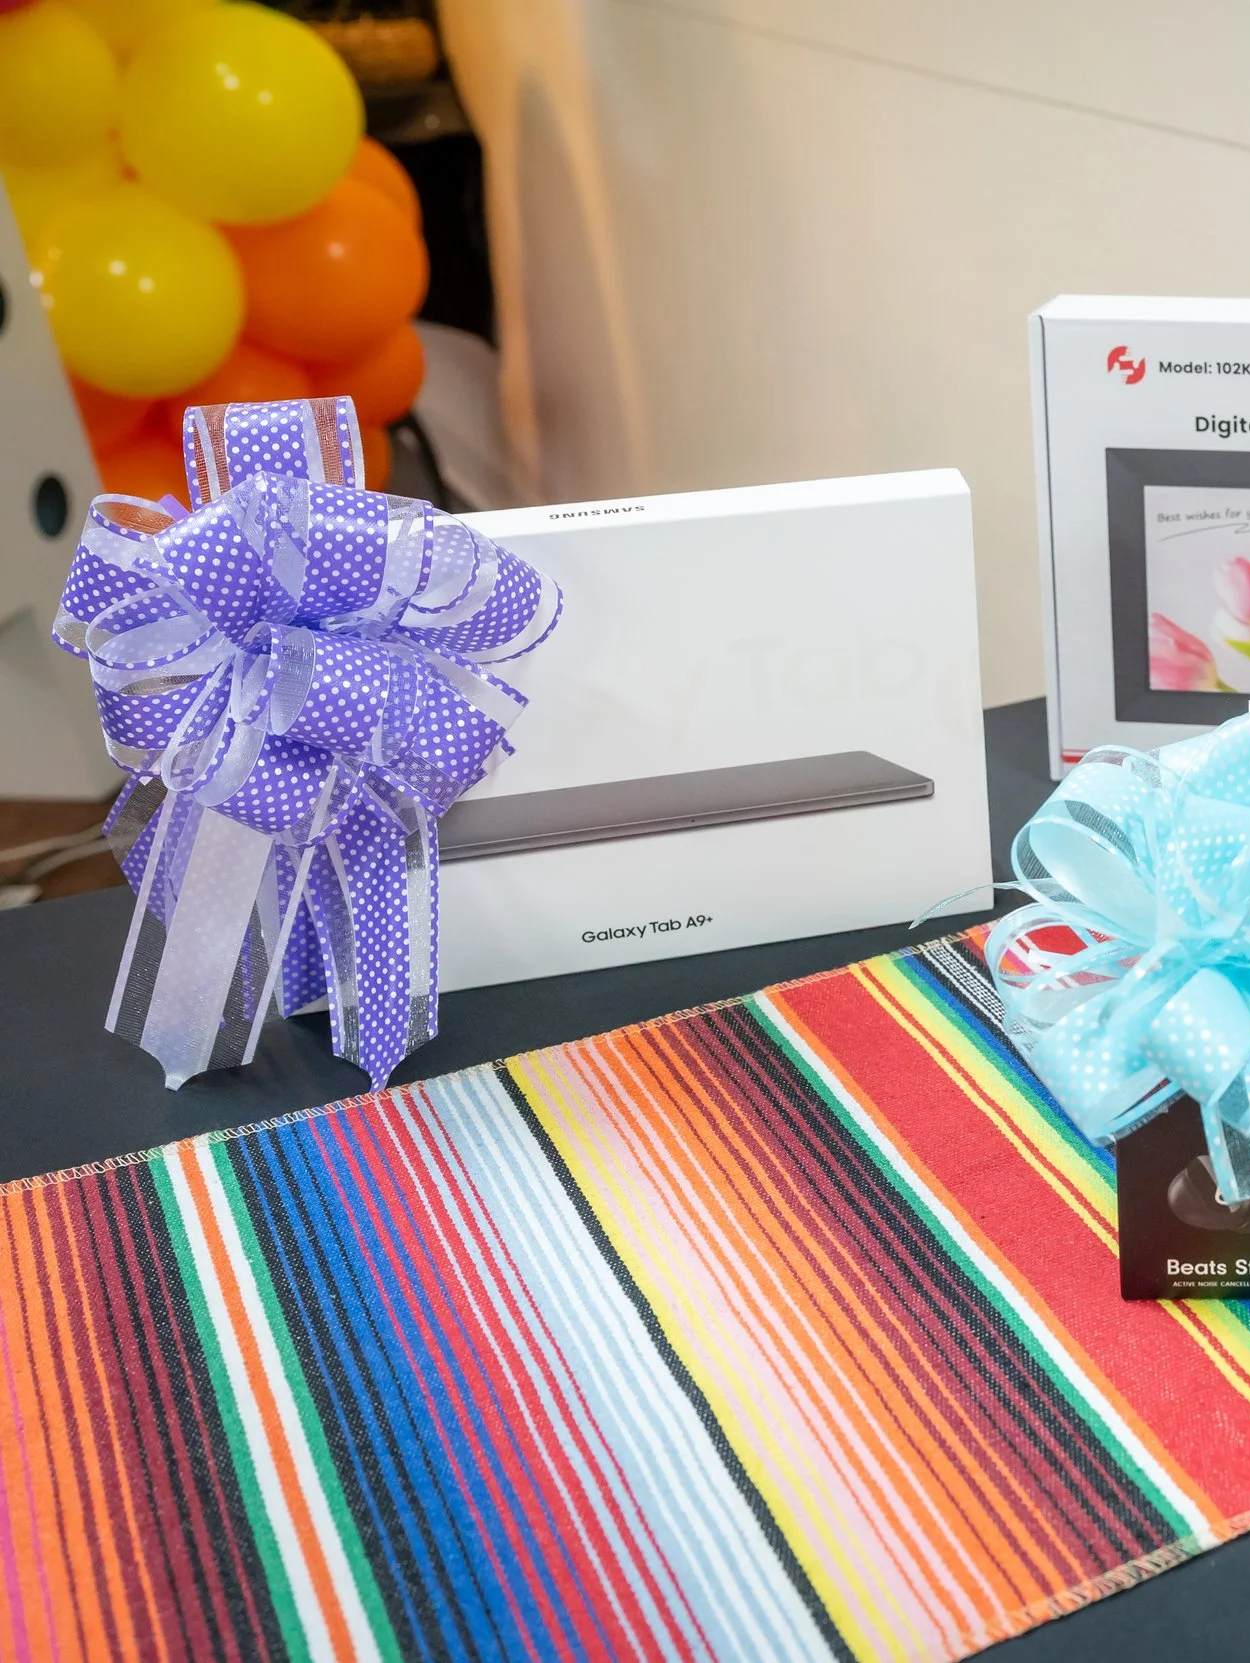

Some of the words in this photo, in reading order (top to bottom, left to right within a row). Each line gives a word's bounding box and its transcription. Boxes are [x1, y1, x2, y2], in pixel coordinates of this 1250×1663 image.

[1159, 361, 1212, 374] Model:
[549, 505, 646, 520] SAMSUNG
[1156, 512, 1180, 524] Best
[1185, 510, 1221, 521] wishes
[1224, 507, 1241, 519] for
[582, 926, 646, 943] Galaxy
[649, 919, 682, 934] Tab
[686, 914, 713, 929] A9+
[1167, 1258, 1228, 1276] Beats
[1172, 1280, 1195, 1288] ACTIVE
